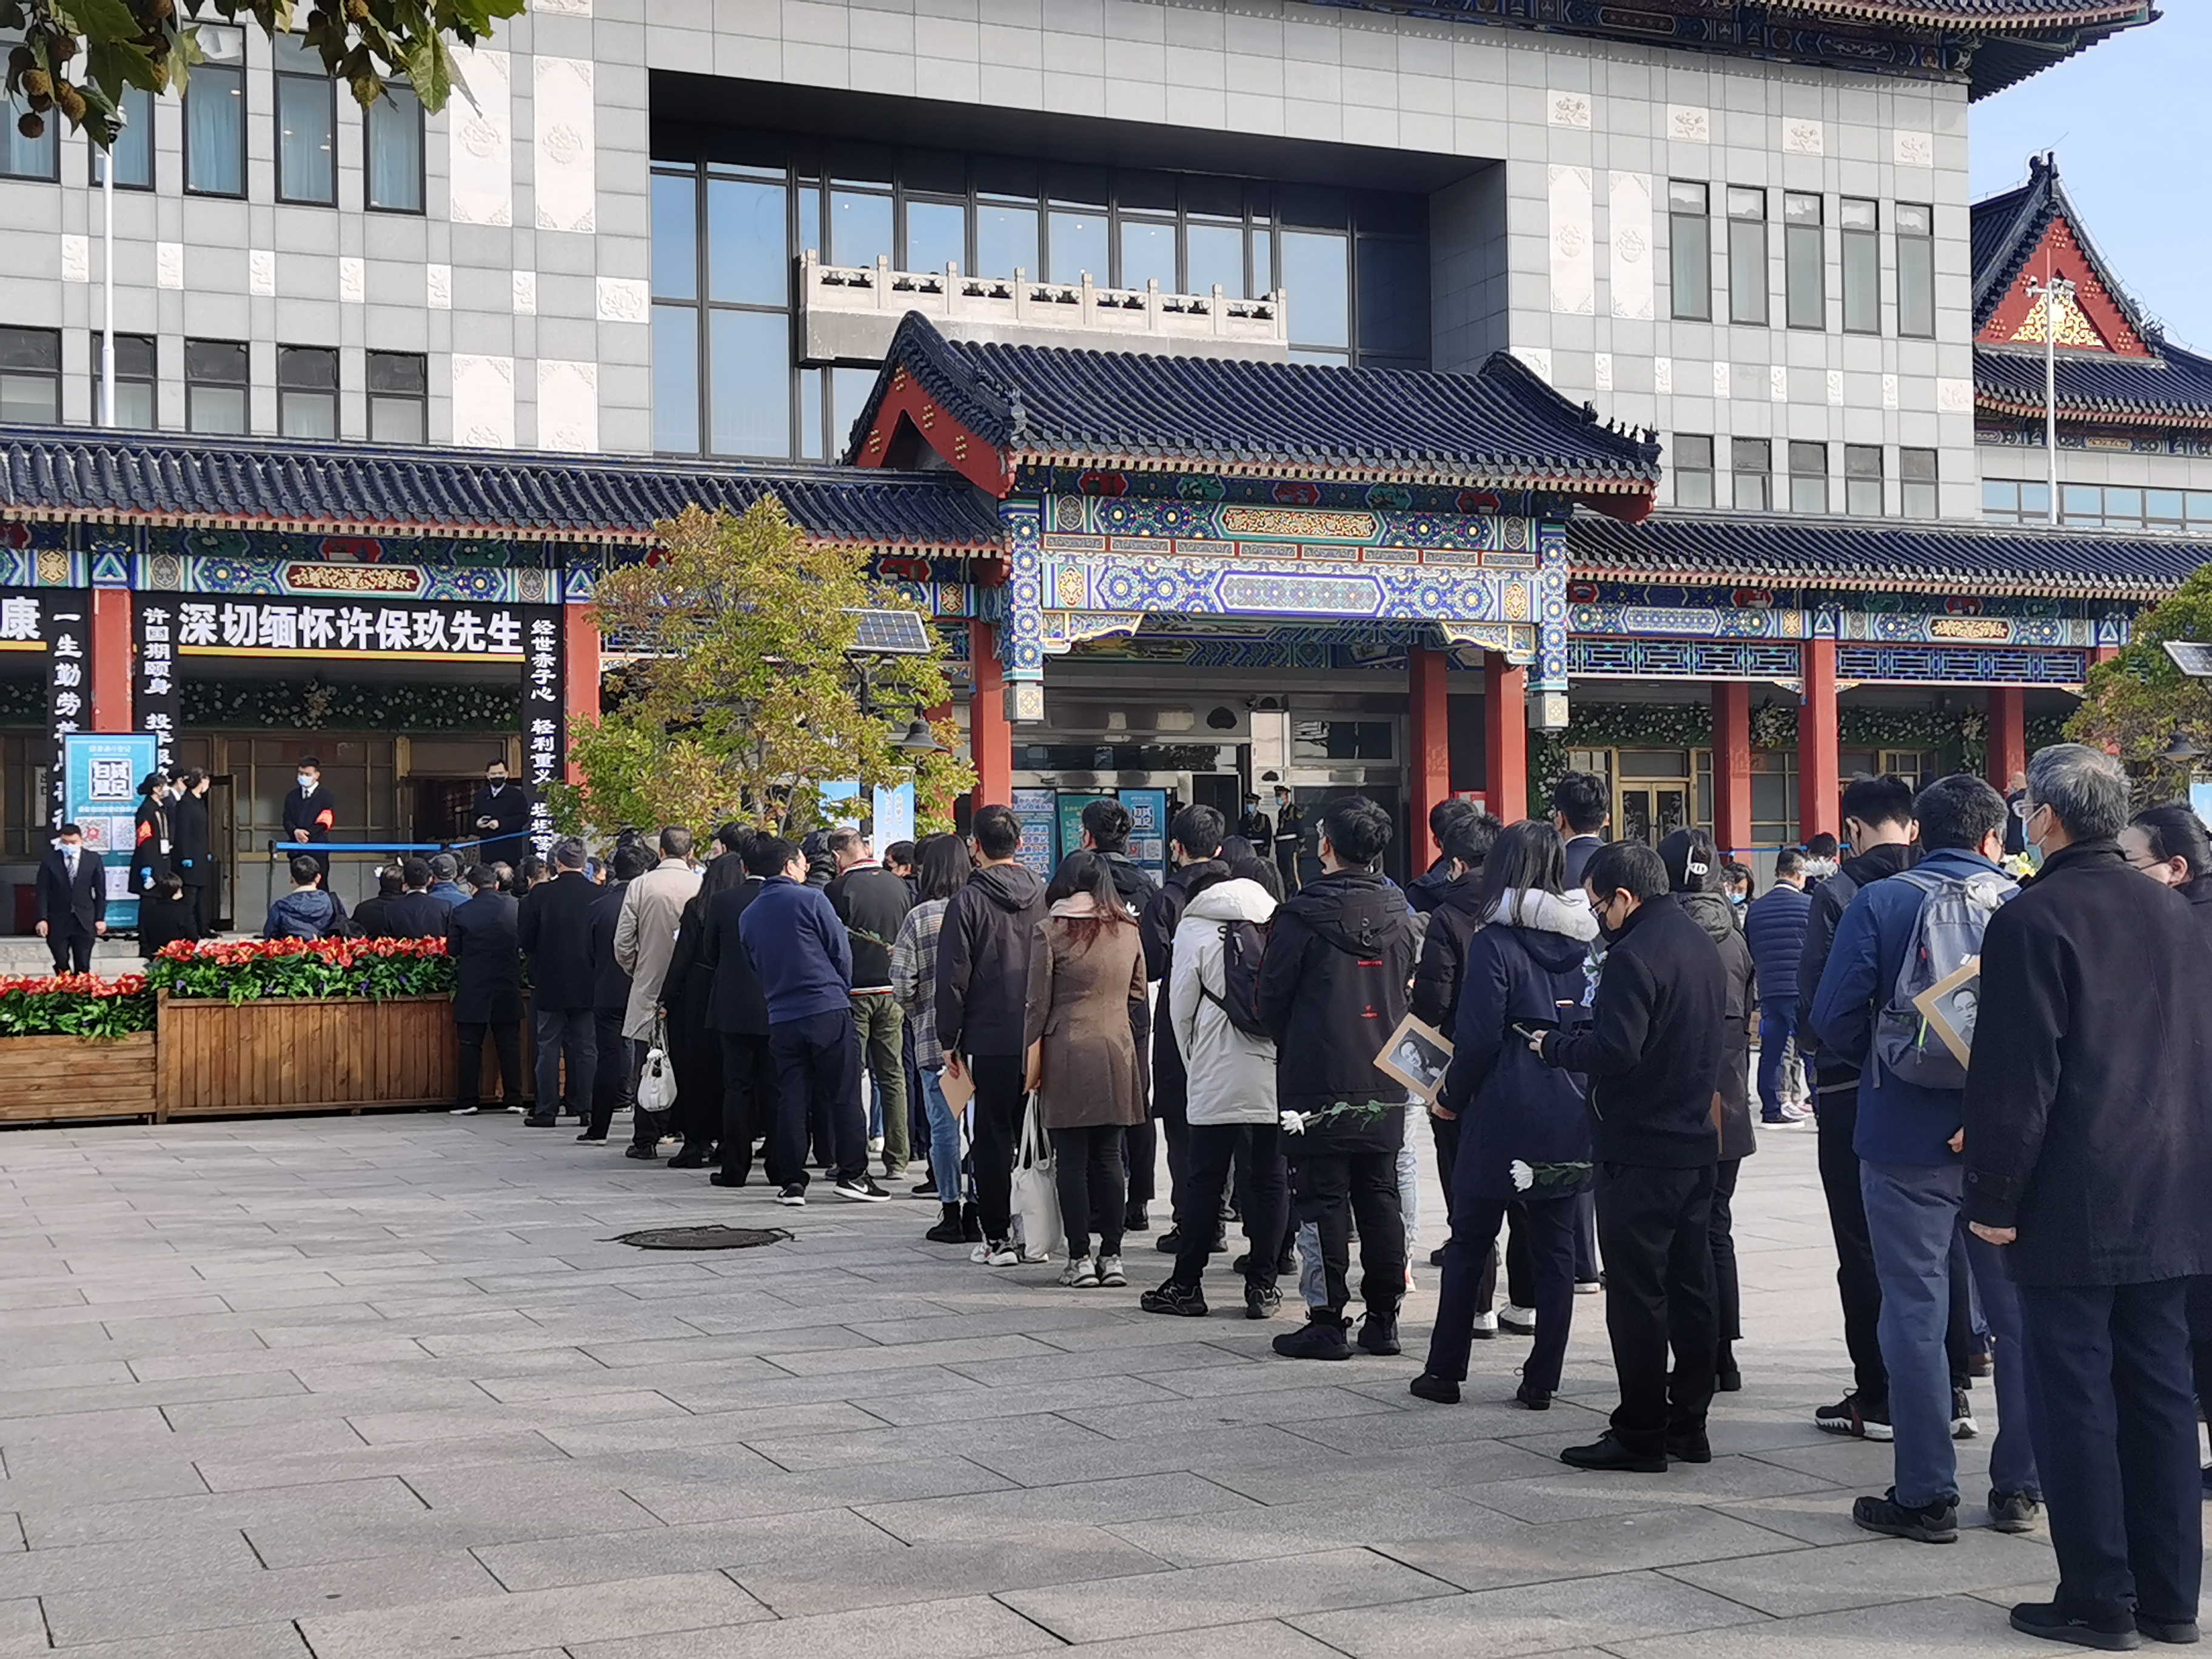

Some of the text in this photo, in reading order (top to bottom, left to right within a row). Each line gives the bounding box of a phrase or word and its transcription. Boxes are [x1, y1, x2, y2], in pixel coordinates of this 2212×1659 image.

[0, 596, 41, 640] 康
[178, 602, 525, 653] 深切缅怀许保玖先生
[530, 619, 557, 702] 经世赤子心
[530, 718, 557, 785] 轻利重义
